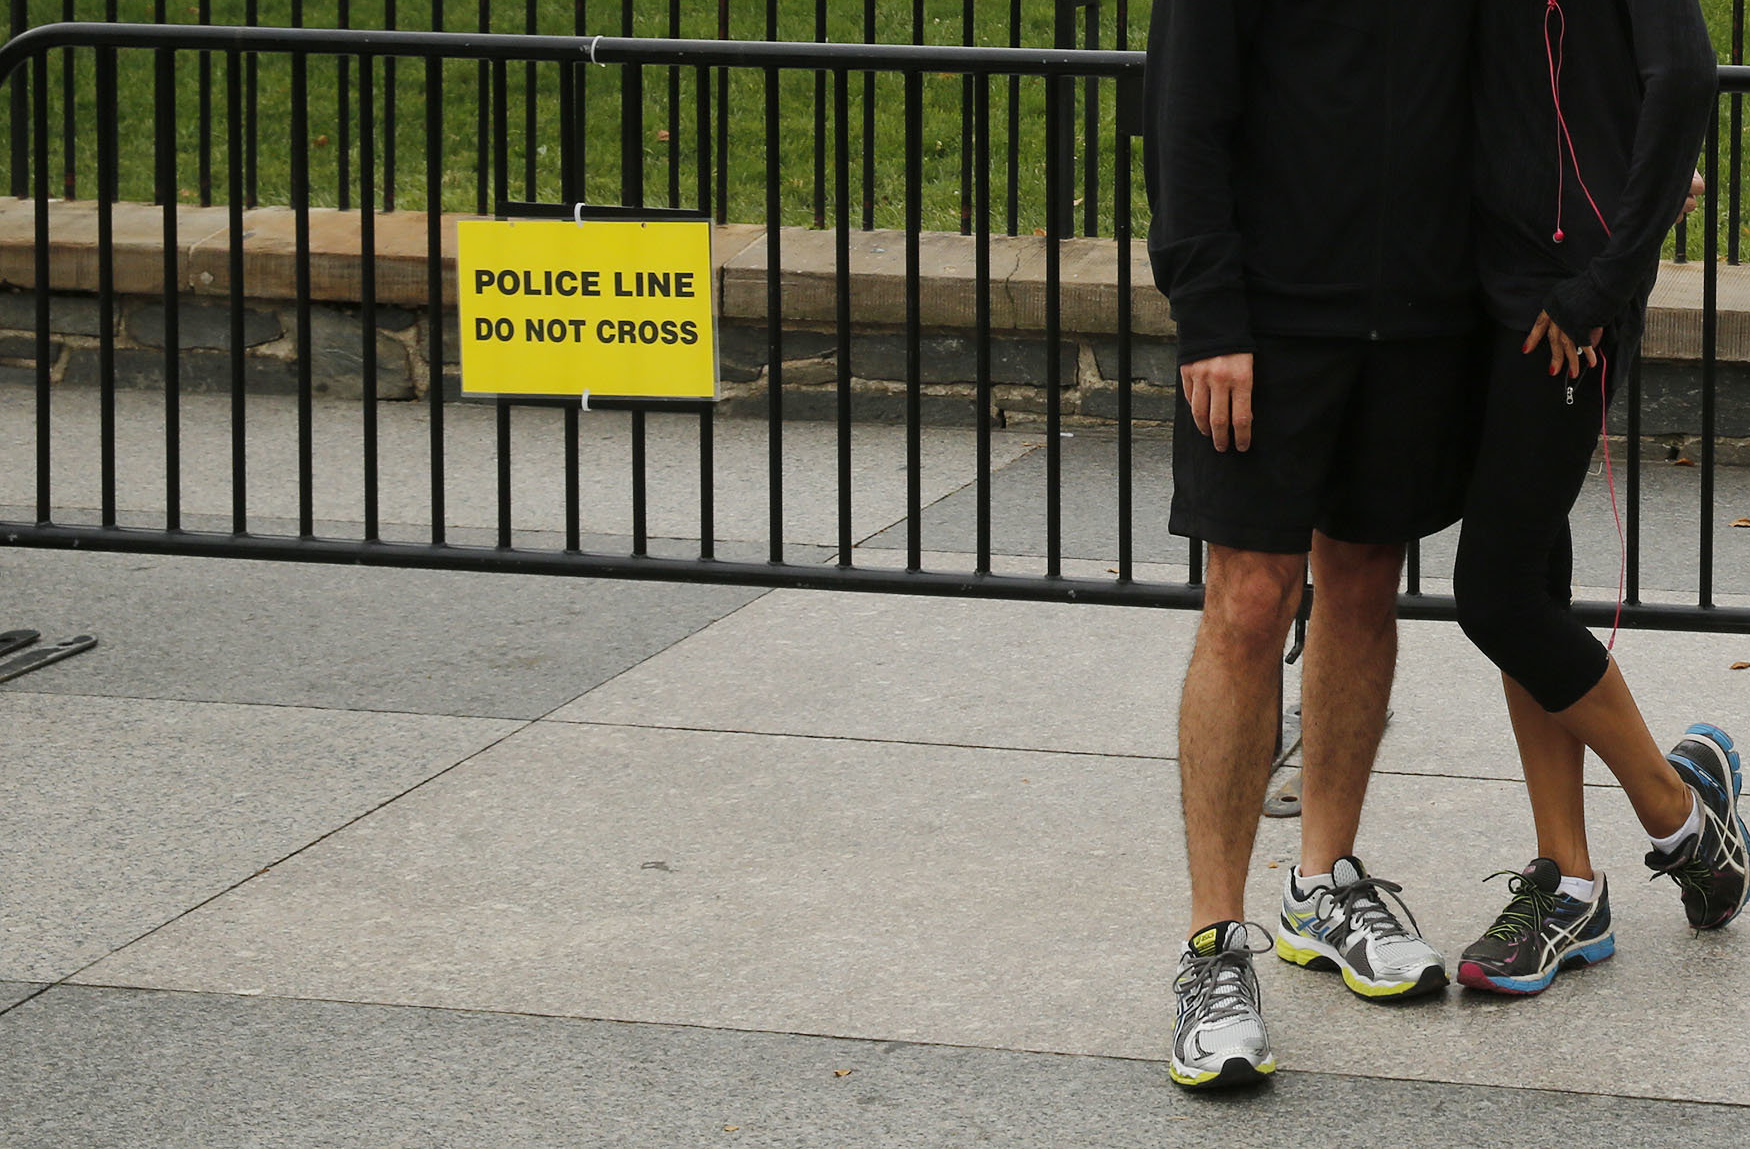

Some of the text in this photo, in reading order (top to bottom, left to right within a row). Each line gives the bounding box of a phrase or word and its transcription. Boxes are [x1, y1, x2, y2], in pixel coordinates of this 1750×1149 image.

[475, 269, 695, 297] POLICE LINE
[475, 317, 698, 345] DO NOT CROSS
